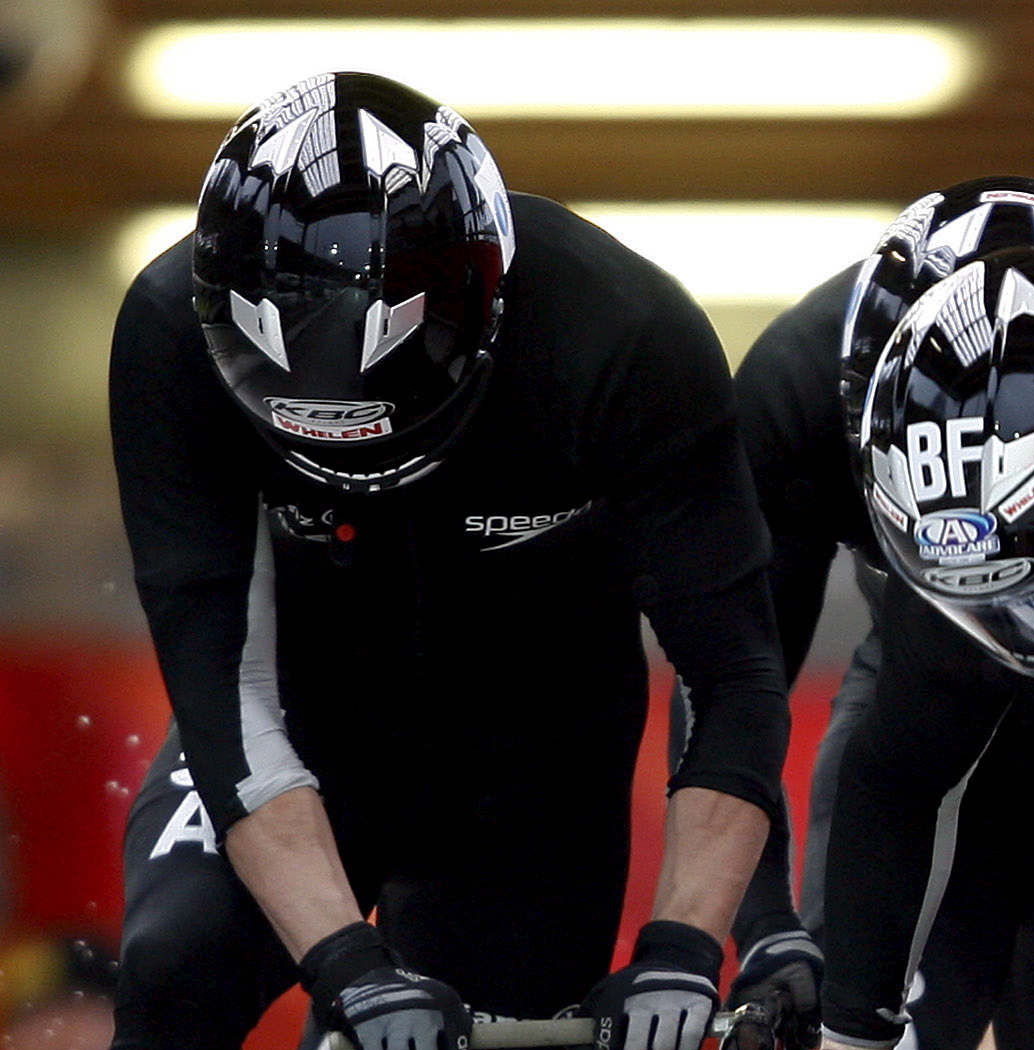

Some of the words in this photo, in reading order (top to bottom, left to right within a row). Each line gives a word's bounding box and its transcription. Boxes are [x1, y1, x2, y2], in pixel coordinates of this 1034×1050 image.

[273, 402, 383, 420] KBC
[277, 416, 383, 439] WHELEN
[907, 416, 984, 501] BF
